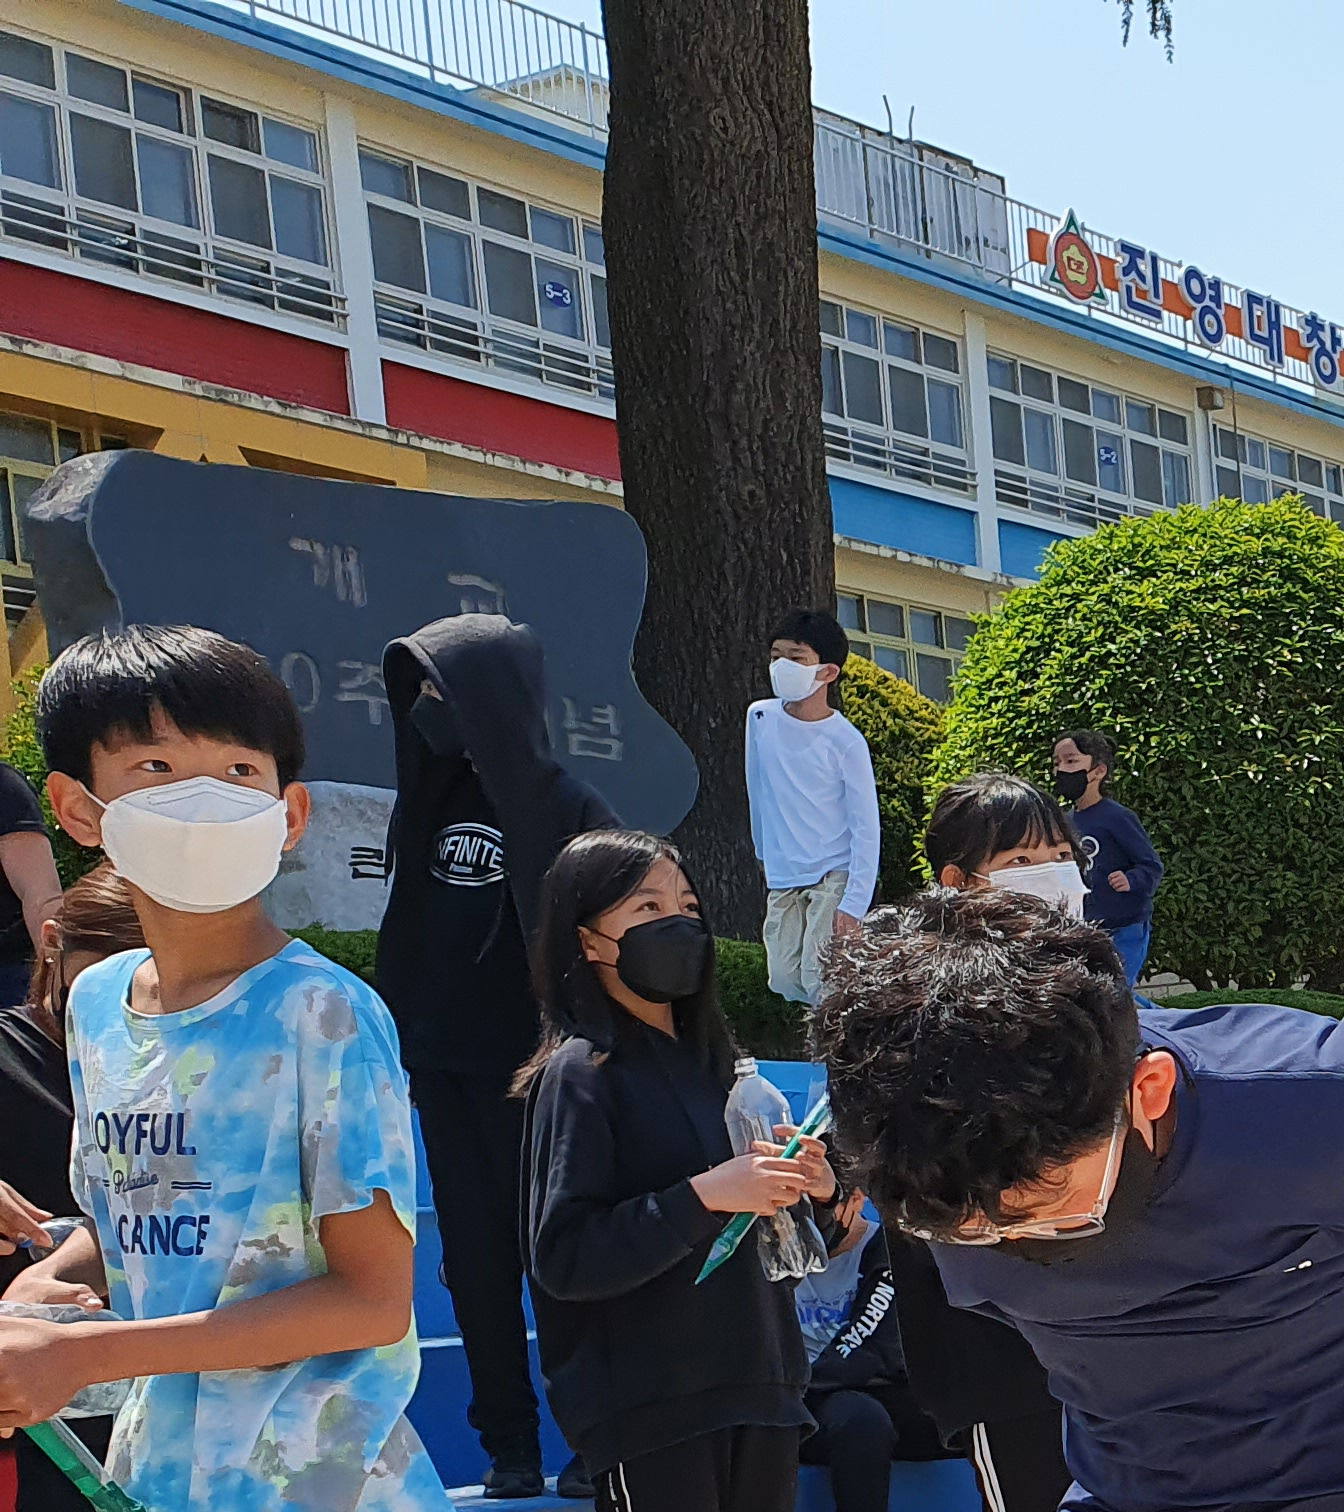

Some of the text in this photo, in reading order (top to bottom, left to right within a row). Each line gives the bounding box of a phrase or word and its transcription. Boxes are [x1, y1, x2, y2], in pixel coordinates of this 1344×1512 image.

[545, 284, 571, 304] 5-3
[94, 1111, 197, 1156] OYFUL
[117, 1214, 211, 1257] CANCE
